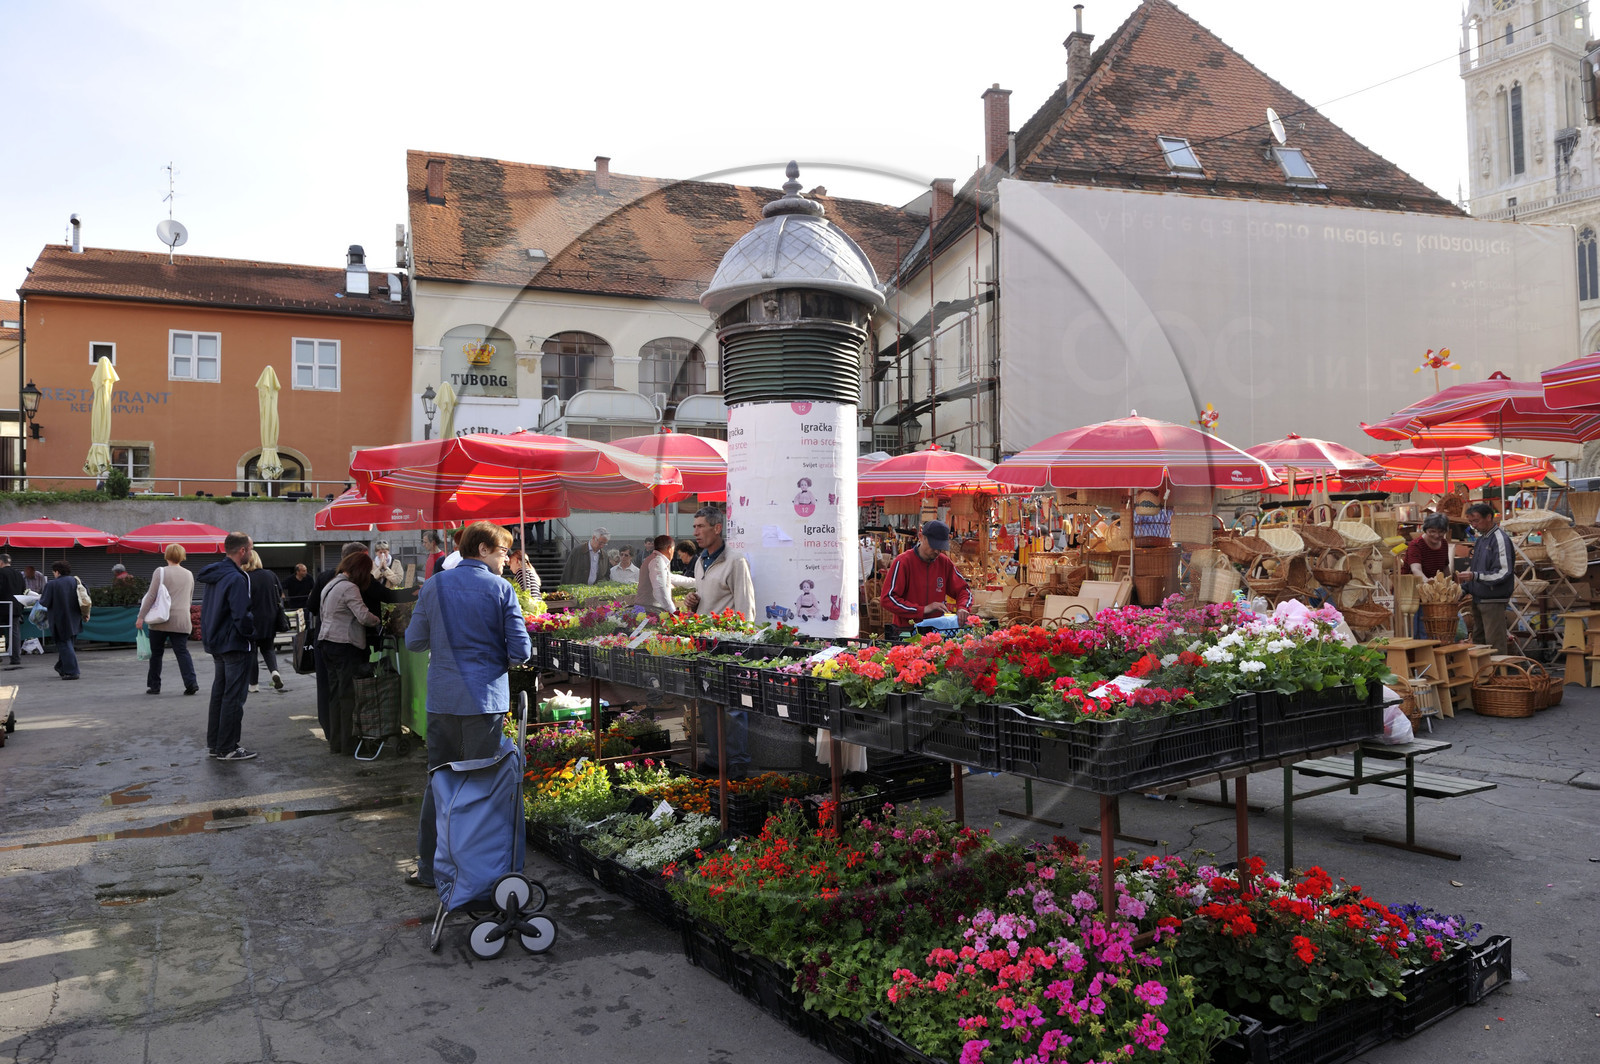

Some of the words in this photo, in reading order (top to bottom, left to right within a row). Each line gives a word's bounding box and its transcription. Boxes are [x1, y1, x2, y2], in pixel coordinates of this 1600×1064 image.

[450, 373, 509, 387] TUBORG
[40, 387, 172, 405] RESTRANT
[797, 404, 806, 412] 12
[800, 422, 833, 433] Igračka
[801, 436, 818, 446] ima
[803, 524, 836, 535] Igračka
[803, 538, 821, 548] ima
